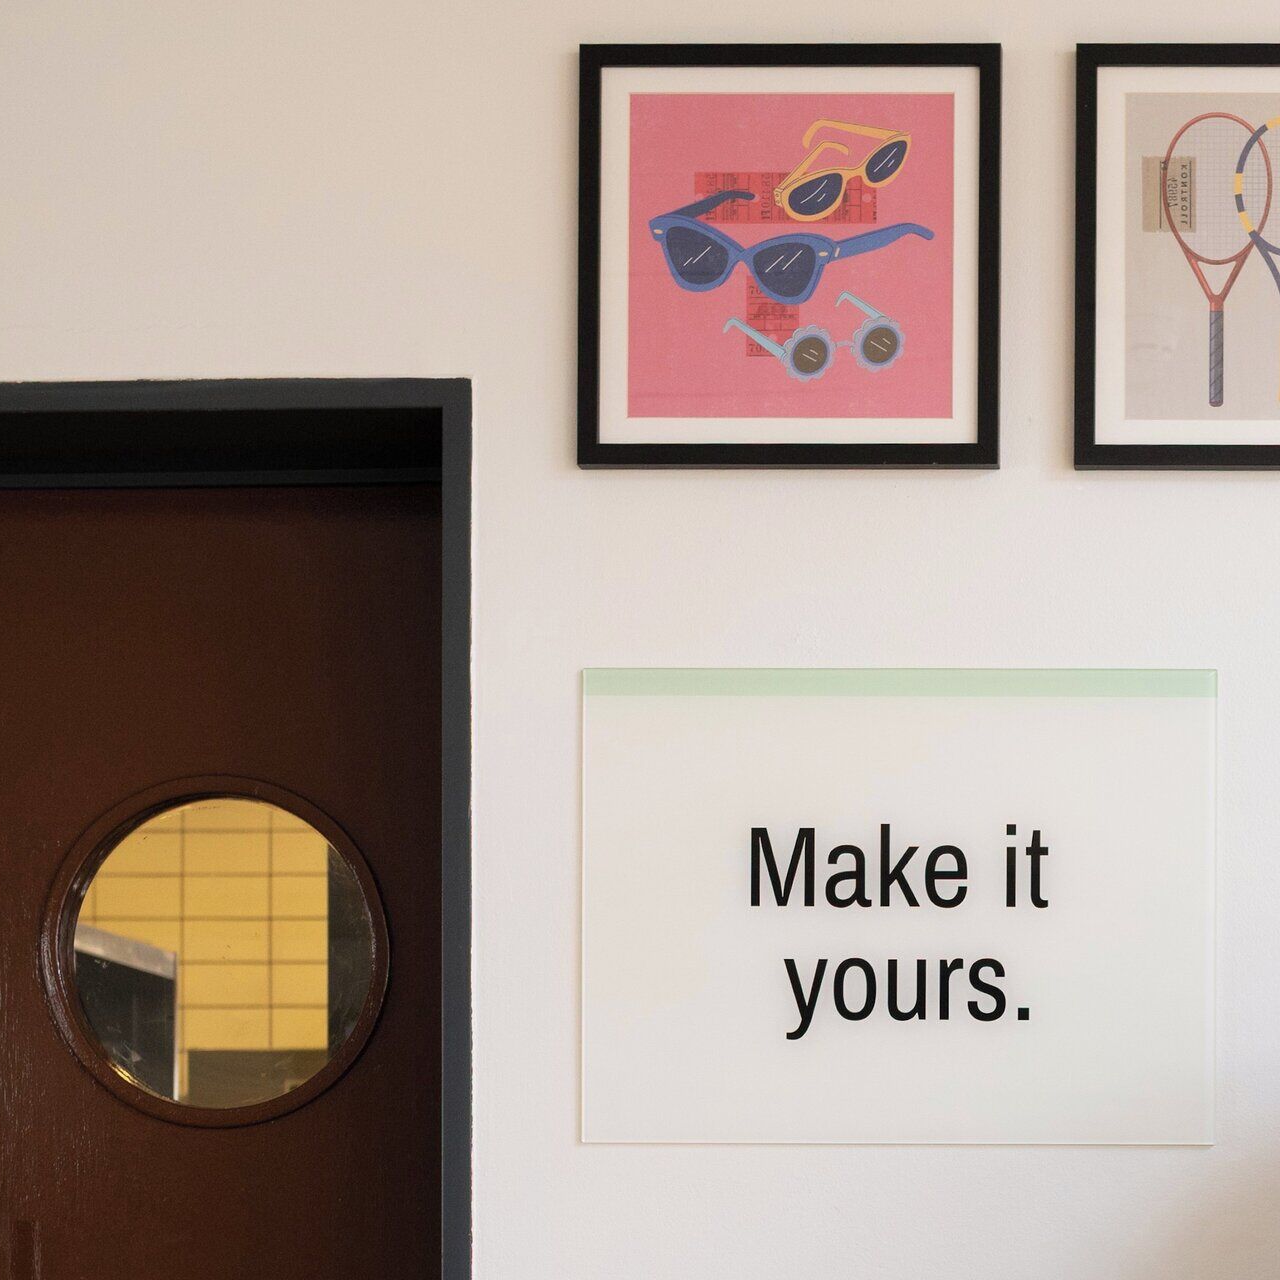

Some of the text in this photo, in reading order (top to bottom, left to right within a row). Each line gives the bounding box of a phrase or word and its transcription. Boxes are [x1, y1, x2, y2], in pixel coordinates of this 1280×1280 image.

[749, 823, 1050, 908] Make it
[784, 957, 1030, 1041] yours.
